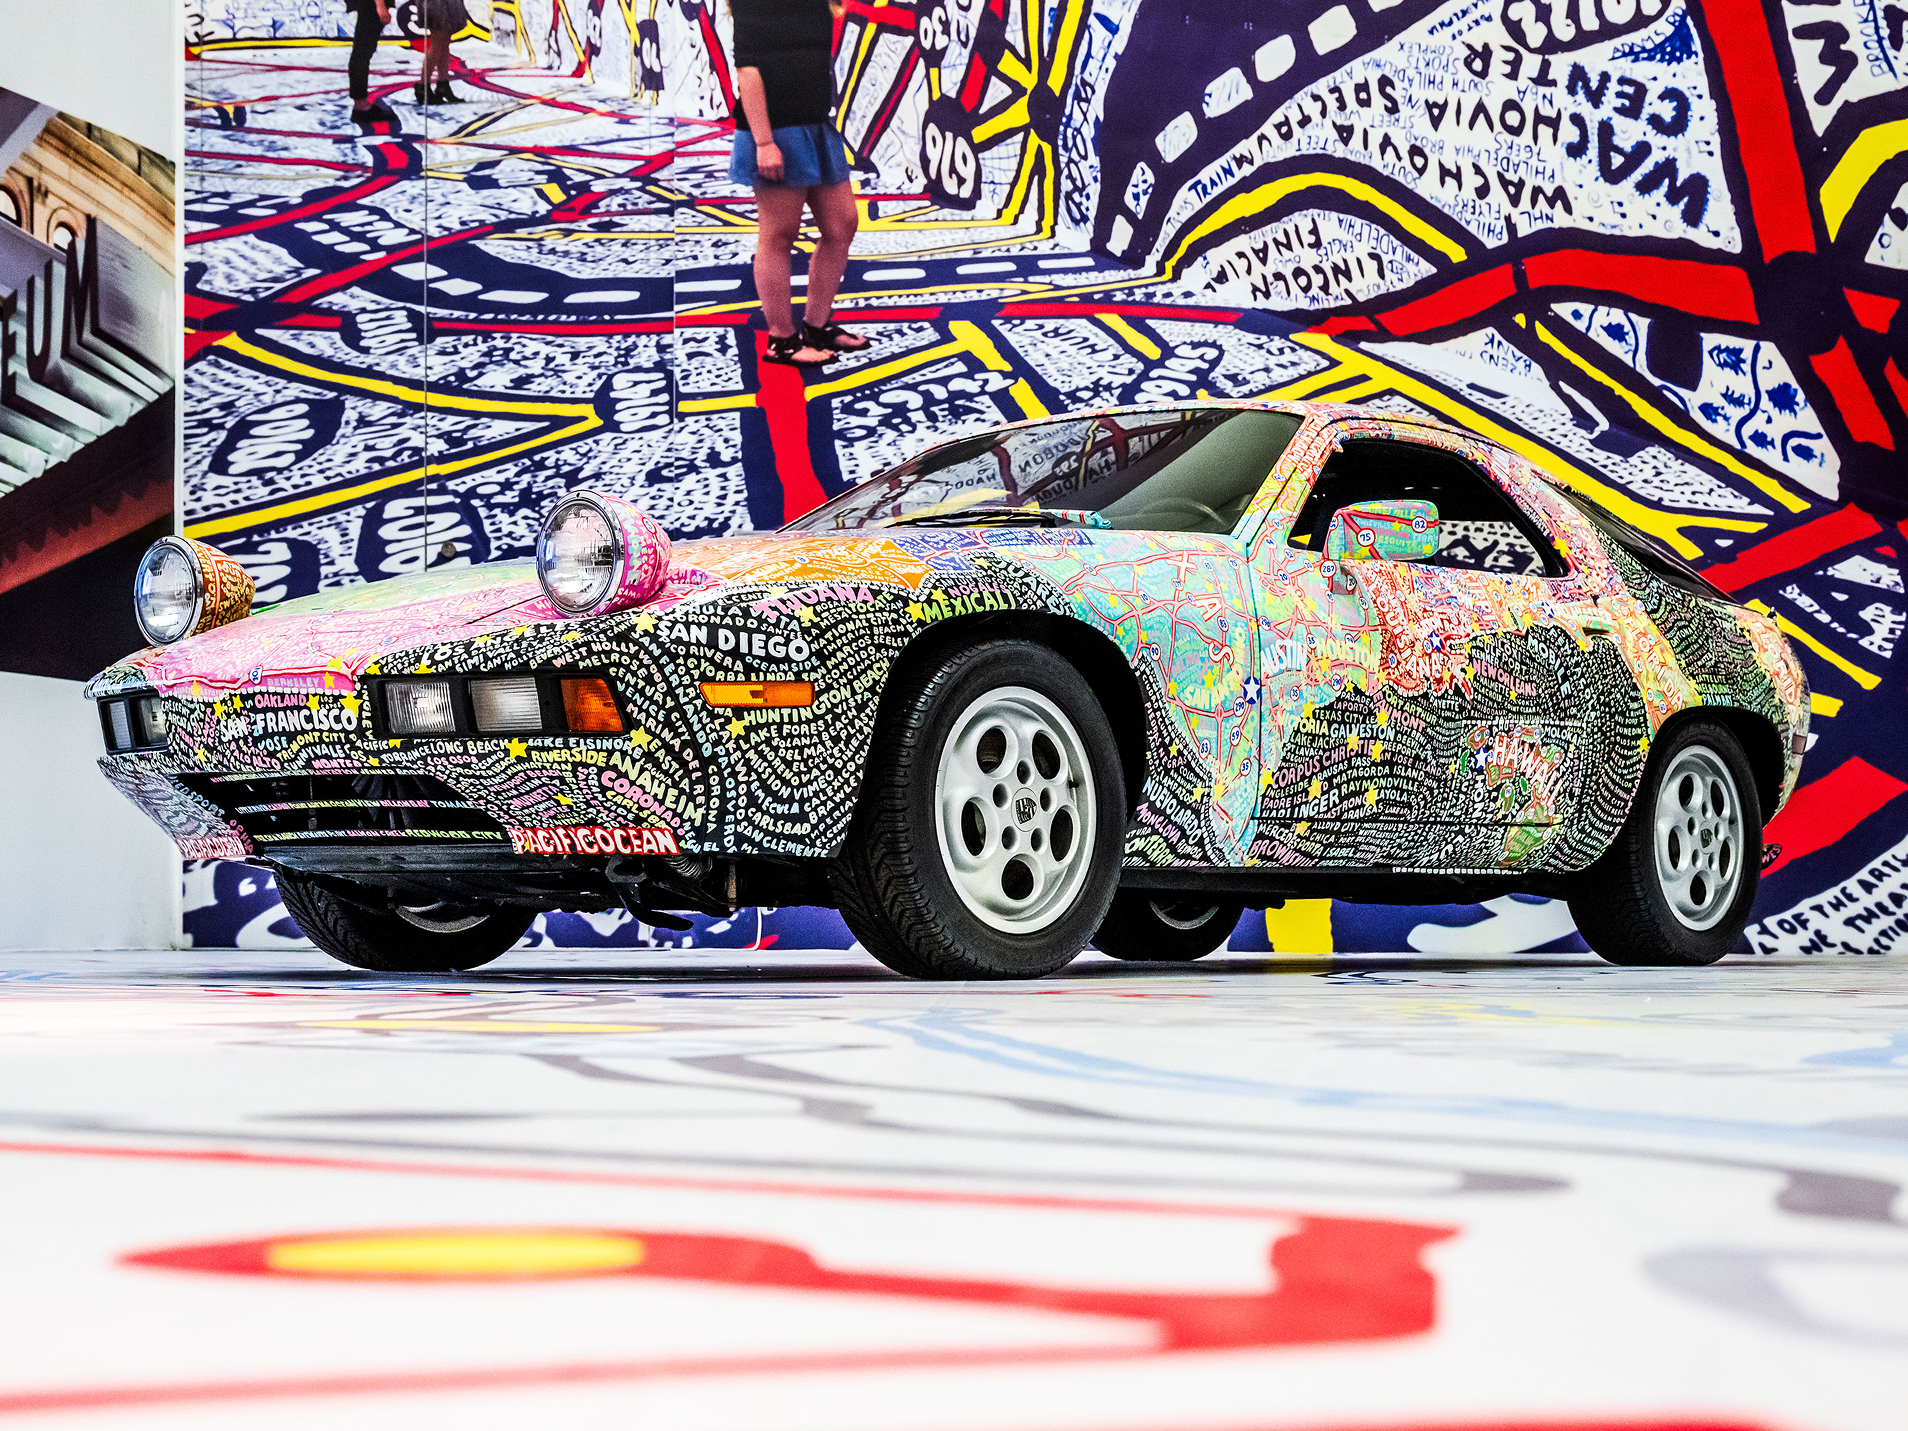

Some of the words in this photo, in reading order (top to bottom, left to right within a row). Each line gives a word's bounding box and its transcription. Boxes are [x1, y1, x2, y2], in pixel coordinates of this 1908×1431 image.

[1397, 41, 1453, 57] COMPLEX
[1362, 57, 1444, 92] PHILADELPHIA
[1406, 55, 1460, 76] SPORTS
[1452, 78, 1495, 97] SOUTH
[1516, 84, 1554, 109] NBA
[1369, 114, 1415, 130] STREET
[1405, 130, 1445, 155] BROAD
[1383, 163, 1421, 190] SOUTH
[1454, 145, 1555, 184] PHILADELPHIA
[1453, 193, 1501, 219] FLYERS
[1520, 210, 1555, 228] NHL
[1316, 237, 1354, 264] EAGLES
[1337, 215, 1420, 267] PHILADELPHIA
[1252, 252, 1385, 301] LINCOLN
[1484, 332, 1532, 374] BANK
[1359, 533, 1371, 542] 75
[1414, 519, 1426, 530] 82
[1322, 564, 1335, 573] 287
[752, 586, 875, 620] TIJUANA
[849, 590, 894, 613] TOCATE
[948, 580, 1008, 599] NOGALES
[922, 587, 1016, 621] MEXICALI
[656, 620, 708, 645] SAN
[717, 627, 811, 663] DIEGO
[810, 617, 870, 652] NATIONAL
[823, 627, 871, 656] IMPERIAL
[873, 624, 906, 636] BEACH
[578, 652, 648, 679] MELROSE
[659, 635, 687, 656] PICO
[689, 646, 744, 672] RIVERA
[745, 655, 821, 673] OCEANSIDE
[825, 635, 872, 669] MARCOS
[1260, 639, 1310, 677] AUSTIN
[1314, 637, 1380, 674] HOUSTON
[1622, 616, 1685, 711] FLORIDA
[551, 646, 588, 669] WEST
[590, 641, 668, 693] HOLLYWOOD
[700, 658, 746, 682] YORBA
[750, 671, 796, 682] LINDA
[815, 645, 876, 691] ESCONDIDO
[833, 648, 888, 689] ENCINATAS
[1472, 658, 1497, 681] NEW
[1497, 667, 1537, 697] ORLEANS
[1527, 635, 1572, 698] MOBILE
[254, 694, 308, 708] OAKLAND
[608, 666, 676, 710] CENTURY
[670, 711, 691, 741] CITY
[616, 680, 667, 722] VENICE
[631, 629, 663, 657] SAN
[659, 654, 714, 758] FERNANDO
[743, 685, 852, 726] HUNTINGTON
[852, 657, 891, 695] BEACH
[833, 690, 872, 715] VISTA
[1291, 689, 1299, 698] 35
[1341, 691, 1380, 714] PASADENA
[1234, 701, 1246, 713] 290
[1314, 709, 1343, 722] TEXAS
[1344, 711, 1363, 724] CITY
[1403, 702, 1438, 726] ARTHUR
[219, 716, 249, 743] SAN
[255, 708, 358, 734] FRANCISCO
[321, 732, 347, 744] CITY
[739, 725, 779, 750] LAKE
[782, 713, 834, 737] FOREST
[771, 735, 820, 748] SOLANA
[821, 707, 858, 741] BEACH
[1231, 730, 1241, 742] 59
[1290, 731, 1313, 746] LAKE
[1330, 723, 1396, 741] GALVESTON
[257, 735, 289, 752] JOSE
[380, 744, 430, 764] TORRANCE
[429, 741, 464, 755] LONG
[467, 738, 509, 755] BEACH
[568, 737, 644, 760] ELSINORE
[625, 702, 682, 752] MARINA
[682, 747, 702, 781] DEL
[778, 747, 802, 760] DEL
[803, 739, 834, 759] MAR
[1200, 743, 1209, 754] 83
[252, 755, 282, 771] ALTO
[283, 744, 346, 771] SUNNYVALE
[470, 750, 505, 770] OCEANO
[531, 747, 608, 767] RIVERSIDE
[758, 743, 800, 786] MORENO
[801, 740, 846, 783] VALLEY
[792, 761, 809, 772] EL
[1241, 762, 1250, 772] 35
[1351, 755, 1372, 767] PASS
[1492, 734, 1565, 805] HAWAII
[745, 748, 793, 800] MISSION
[793, 769, 835, 800] VIMEO
[1271, 756, 1321, 789] CORPUS
[1332, 766, 1390, 787] MATAGORDA
[1393, 765, 1425, 781] ISLAND
[588, 766, 636, 821] OCEANSIDE
[608, 751, 704, 827] ANAHEIM
[707, 765, 721, 835] CORONA
[749, 771, 800, 814] TEMECULA
[803, 761, 857, 813] CALEXICO
[808, 768, 865, 825] BRAWLEY
[1266, 779, 1310, 799] INGLESIDE
[1340, 777, 1419, 797] RAYMONDVILLE
[600, 770, 687, 836] CORONADO
[1261, 796, 1292, 809] PADRE
[404, 828, 472, 839] REDWOOD
[471, 830, 503, 840] CITY
[747, 807, 812, 836] CARLSBAD
[805, 796, 859, 845] IMPERIAL
[1136, 802, 1182, 845] MONCLOVA
[1340, 822, 1361, 833] CITY
[736, 821, 765, 843] SAN
[762, 836, 830, 859] CLEMENTE
[1250, 839, 1319, 867] BROWNSVILLE
[1322, 847, 1355, 858] ISABEL
